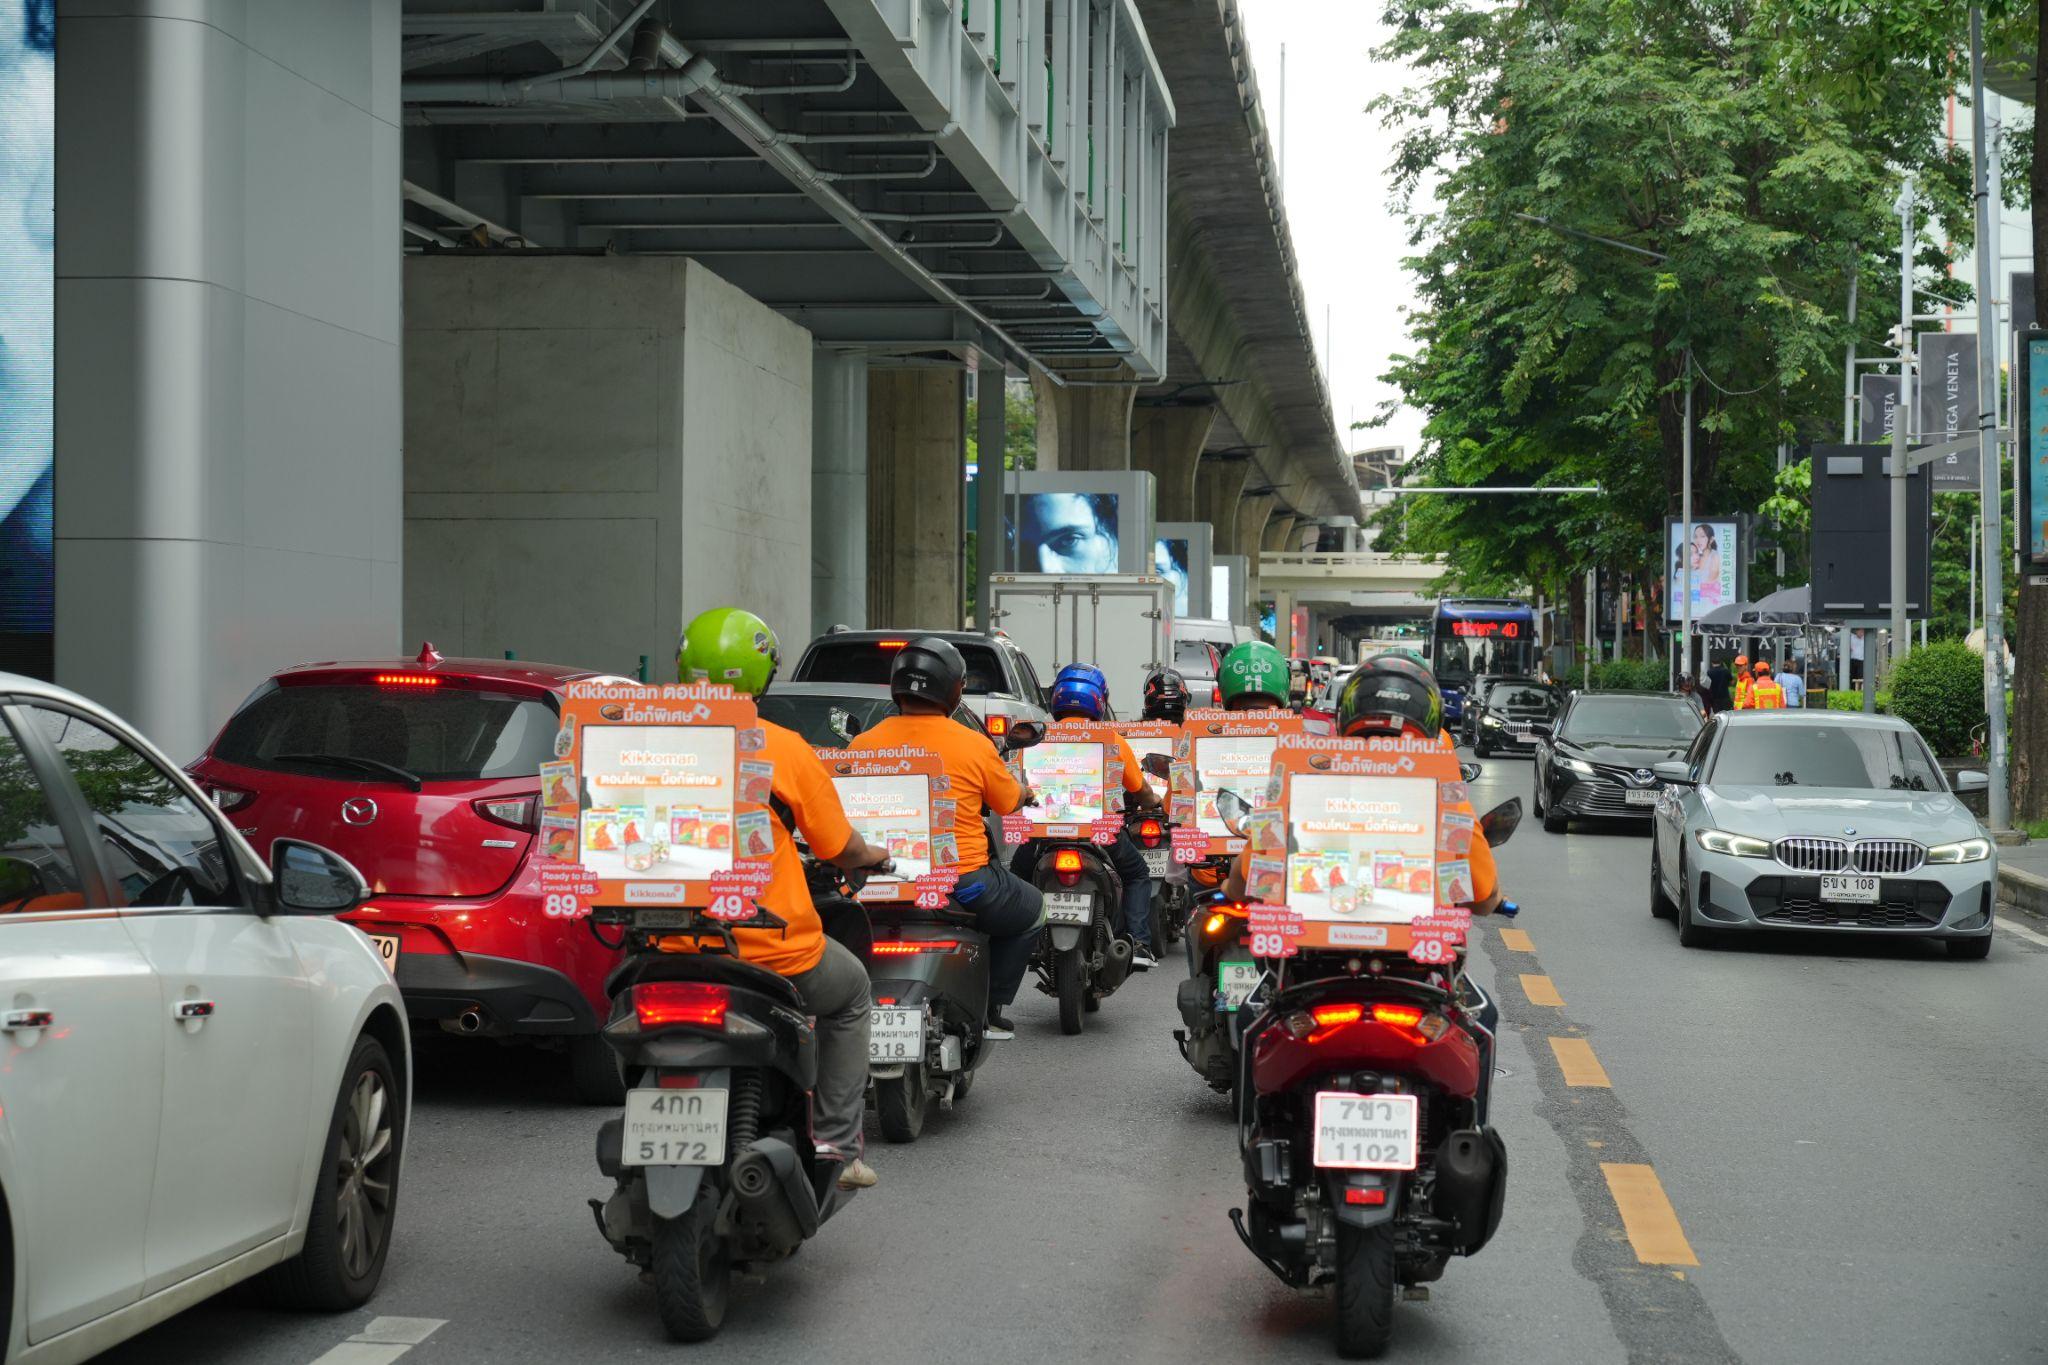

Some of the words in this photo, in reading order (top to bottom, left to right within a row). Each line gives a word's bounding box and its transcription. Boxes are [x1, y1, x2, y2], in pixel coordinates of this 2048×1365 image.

[1946, 352, 1959, 401] VENETA
[1946, 404, 1958, 464] BTEGA
[1722, 528, 1731, 566] BRIGHT
[1722, 569, 1730, 596] BABY
[1501, 622, 1518, 637] 40
[568, 685, 659, 699] Kikkoman
[1376, 690, 1411, 701] REVO
[623, 702, 693, 722] มื้อก็พิเศษ
[1186, 711, 1245, 721] Kikkoman
[1278, 734, 1365, 752] Kikkoman
[620, 753, 697, 765] Kikkoman
[814, 749, 875, 760] Kikkoman
[850, 793, 903, 803] Kikkoman
[1327, 799, 1400, 812] Kikkoman
[1004, 831, 1029, 843] 89.-
[1092, 831, 1117, 843] 49.-
[1175, 847, 1204, 862] 89.-
[542, 872, 569, 882] Ready
[572, 872, 581, 880] to
[582, 872, 597, 881] Eat
[1855, 878, 1875, 890] 108
[630, 887, 676, 898] kikkoman
[861, 887, 893, 896] kikkoman
[545, 893, 590, 916] 89.-
[710, 895, 754, 917] 49.-
[917, 891, 948, 907] 49.-
[1251, 911, 1276, 922] Ready
[1278, 912, 1286, 921] to
[1288, 913, 1302, 922] Eat
[1334, 932, 1378, 941] kikkoman
[1253, 934, 1296, 955] 89.-
[1411, 939, 1454, 961] 49.-
[870, 1043, 906, 1056] 318
[639, 1141, 707, 1161] 5172
[1335, 1142, 1399, 1163] 1102
